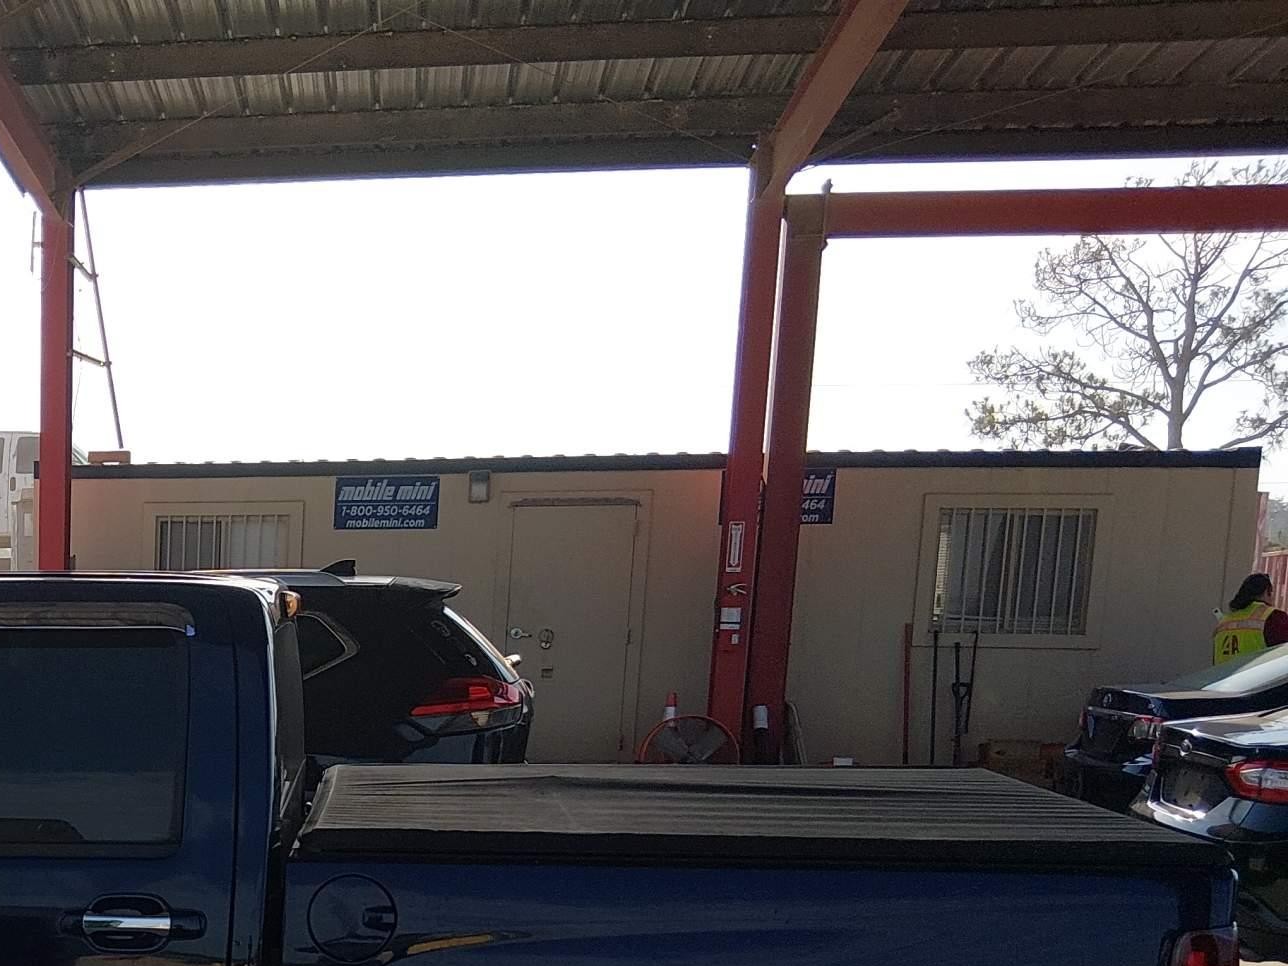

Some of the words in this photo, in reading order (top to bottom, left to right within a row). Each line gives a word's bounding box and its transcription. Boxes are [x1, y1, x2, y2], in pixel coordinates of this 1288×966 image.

[338, 479, 396, 501] mobile
[396, 481, 437, 500] mini
[341, 505, 431, 517] 1-800-950-6464
[345, 518, 425, 528] mobilemini.com
